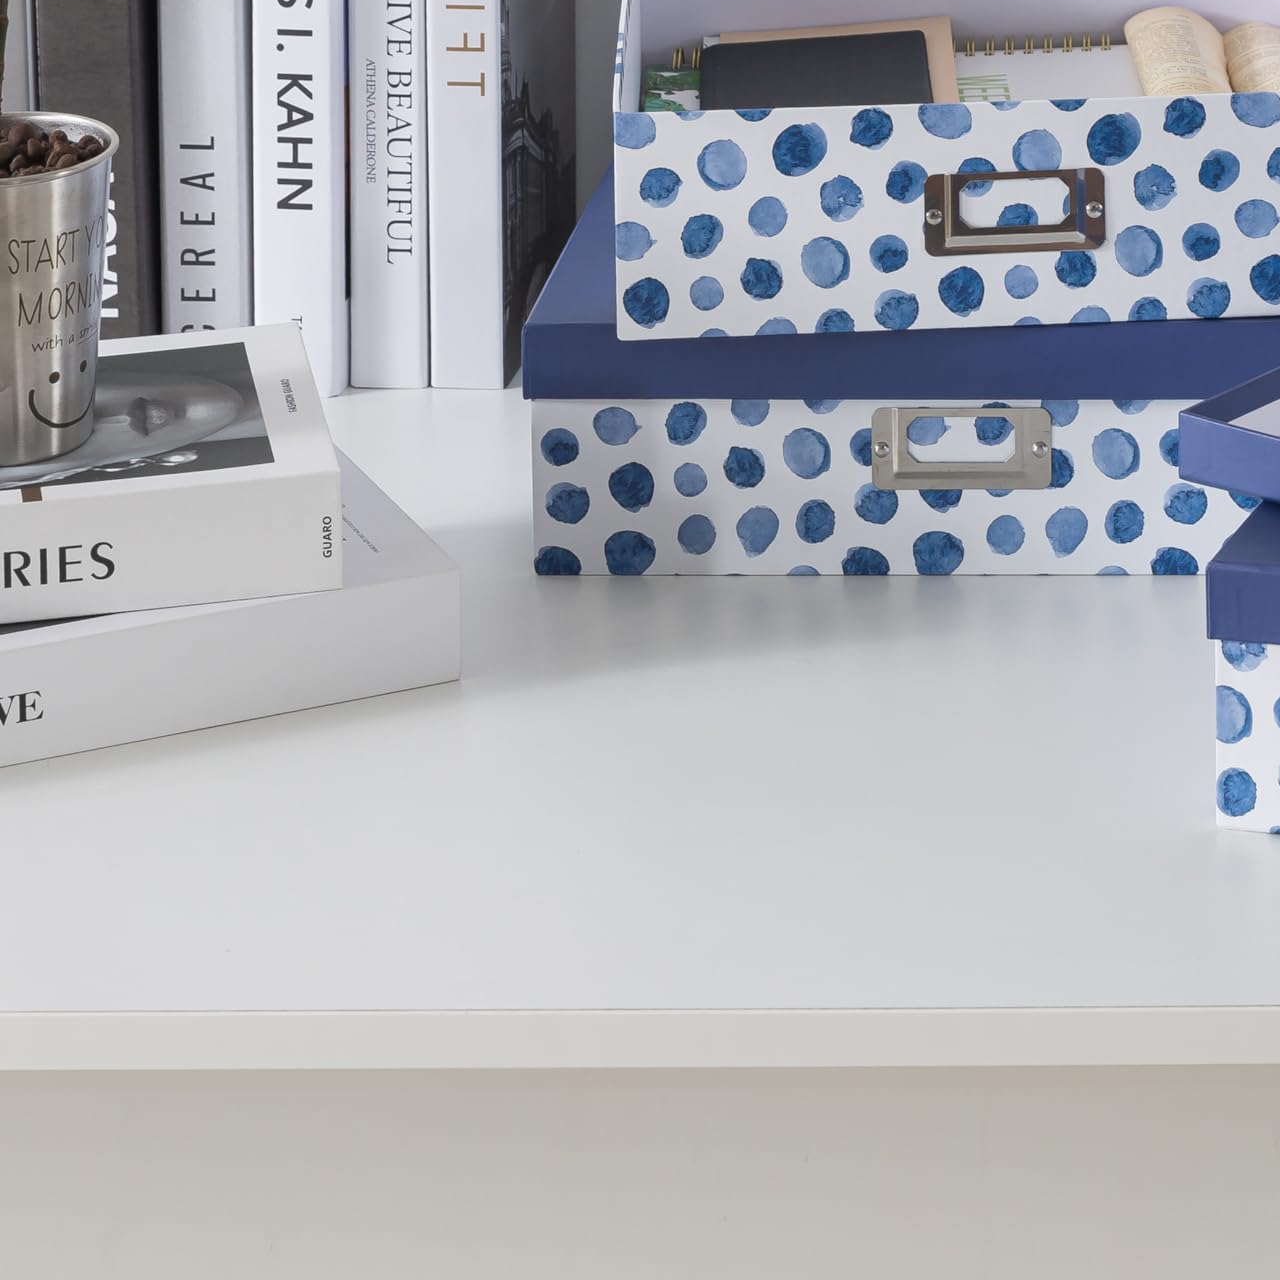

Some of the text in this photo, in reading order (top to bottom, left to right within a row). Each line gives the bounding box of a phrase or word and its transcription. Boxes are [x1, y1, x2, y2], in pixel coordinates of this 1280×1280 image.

[276, 29, 313, 51] I.
[276, 73, 314, 210] KAHN
[365, 58, 377, 184] ATHENA CALDERONE
[386, 68, 413, 265] BEAUTIFUL
[8, 228, 80, 275] START
[31, 334, 63, 352] with
[68, 334, 75, 344] a
[322, 515, 332, 558] GUARO
